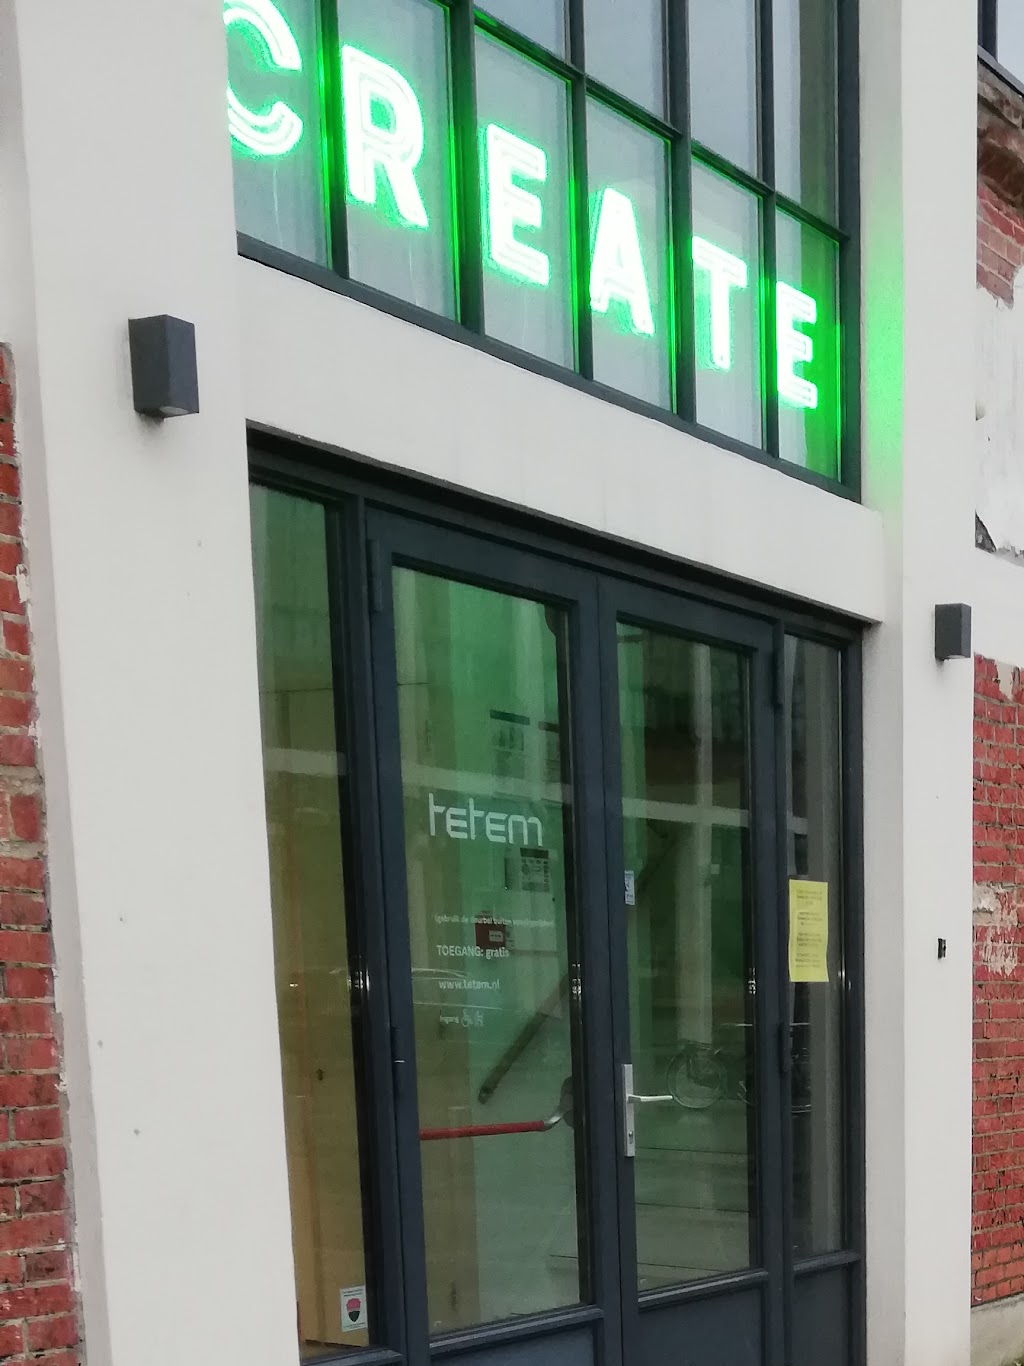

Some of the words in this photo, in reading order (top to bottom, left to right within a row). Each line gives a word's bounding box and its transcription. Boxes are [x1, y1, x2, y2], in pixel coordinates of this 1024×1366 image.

[223, 0, 819, 410] CREATE
[428, 793, 543, 847] tetem
[436, 944, 484, 957] TOEGANG:
[485, 947, 510, 960] gratis
[438, 978, 500, 990] www.tetem.nl
